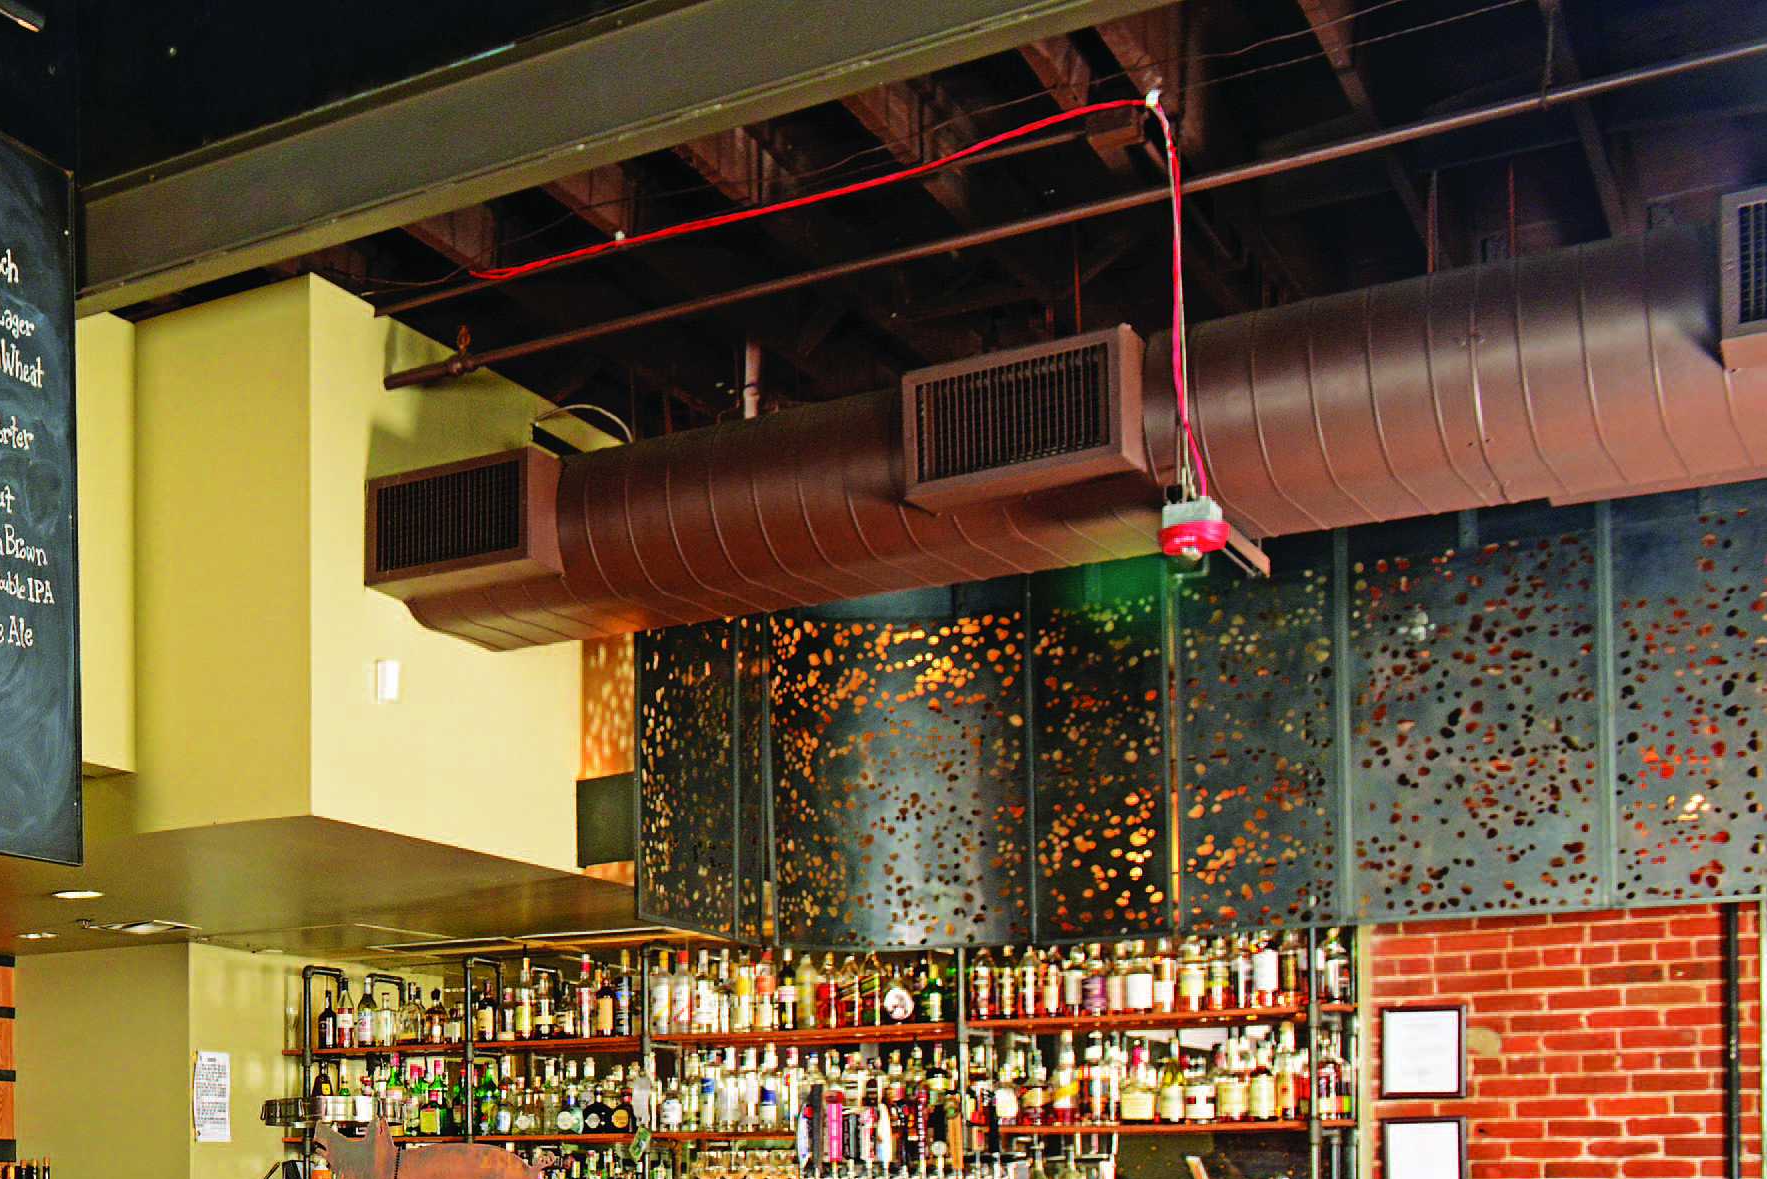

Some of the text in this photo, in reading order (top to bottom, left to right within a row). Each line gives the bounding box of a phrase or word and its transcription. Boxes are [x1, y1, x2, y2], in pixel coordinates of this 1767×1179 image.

[0, 338, 45, 388] Wheat
[5, 523, 48, 566] Brown
[27, 577, 55, 604] IPA
[8, 615, 34, 648] Ale
